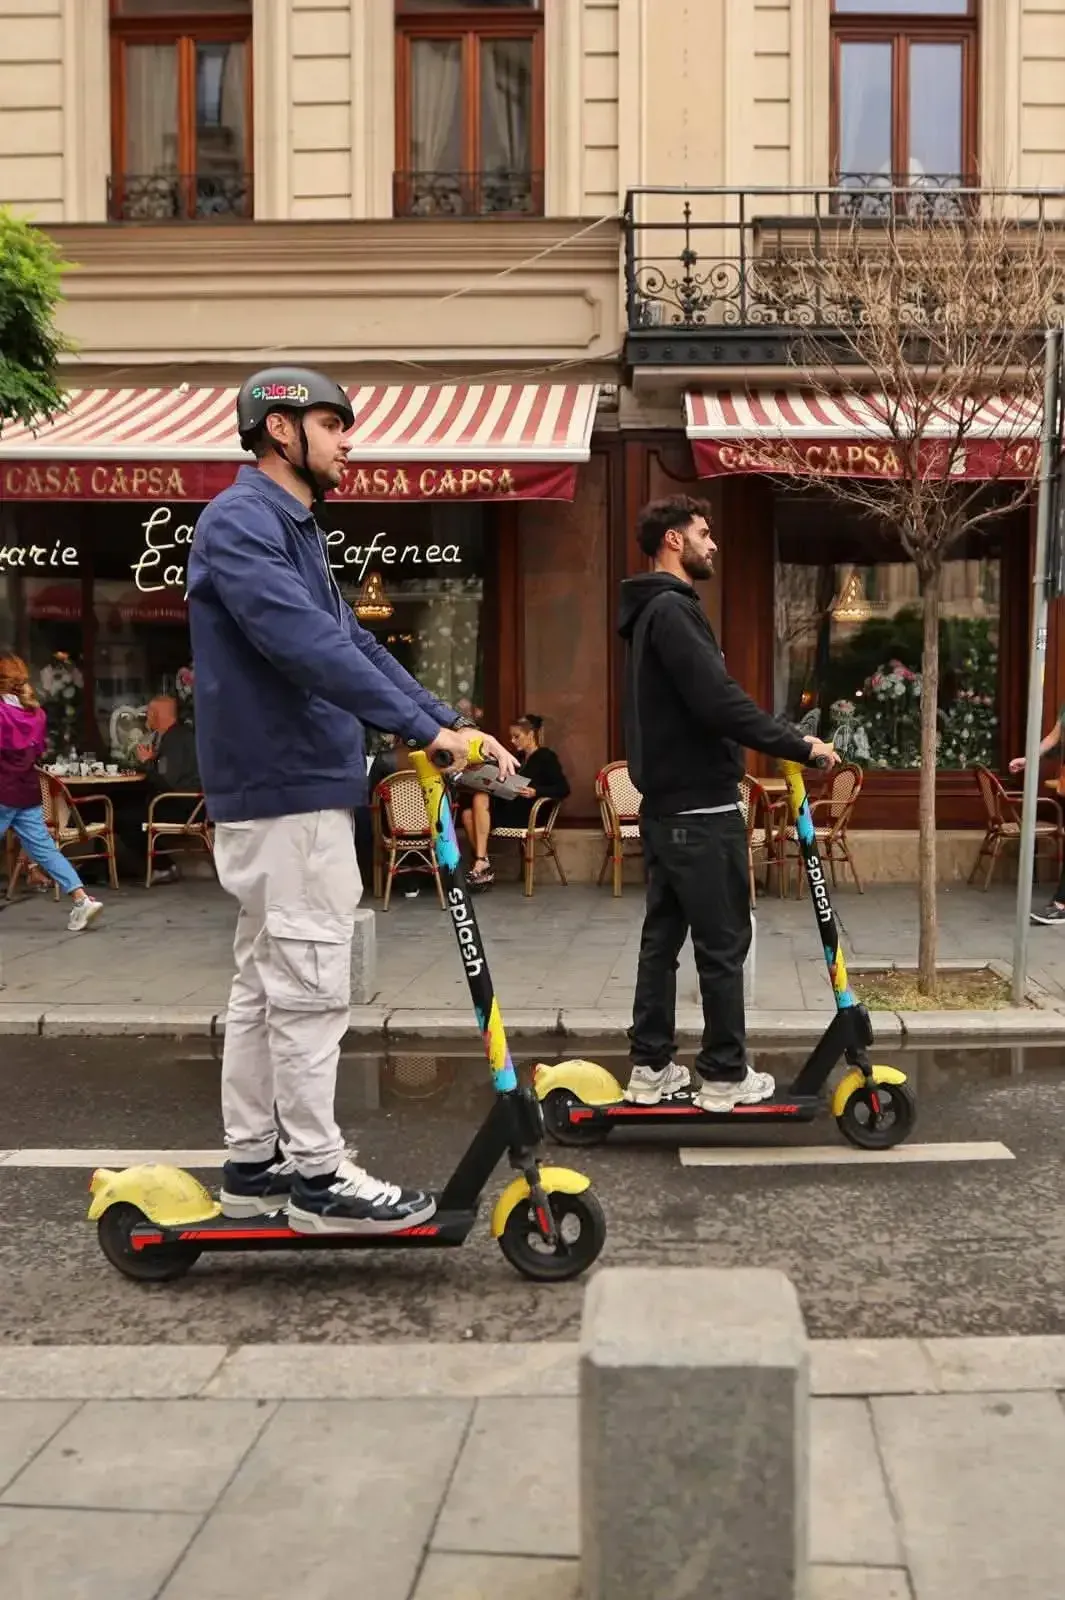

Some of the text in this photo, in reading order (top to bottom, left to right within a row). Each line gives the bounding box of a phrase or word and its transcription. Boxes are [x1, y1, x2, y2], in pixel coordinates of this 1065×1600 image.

[251, 384, 309, 400] splash
[6, 466, 187, 496] CASA CAPSA
[806, 446, 901, 474] CAPSA
[419, 468, 517, 496] CAPSA
[141, 507, 194, 550] Ca
[130, 549, 189, 601] Ca
[326, 530, 462, 581] Cafenea
[807, 855, 832, 923] splash
[448, 887, 484, 977] splash
